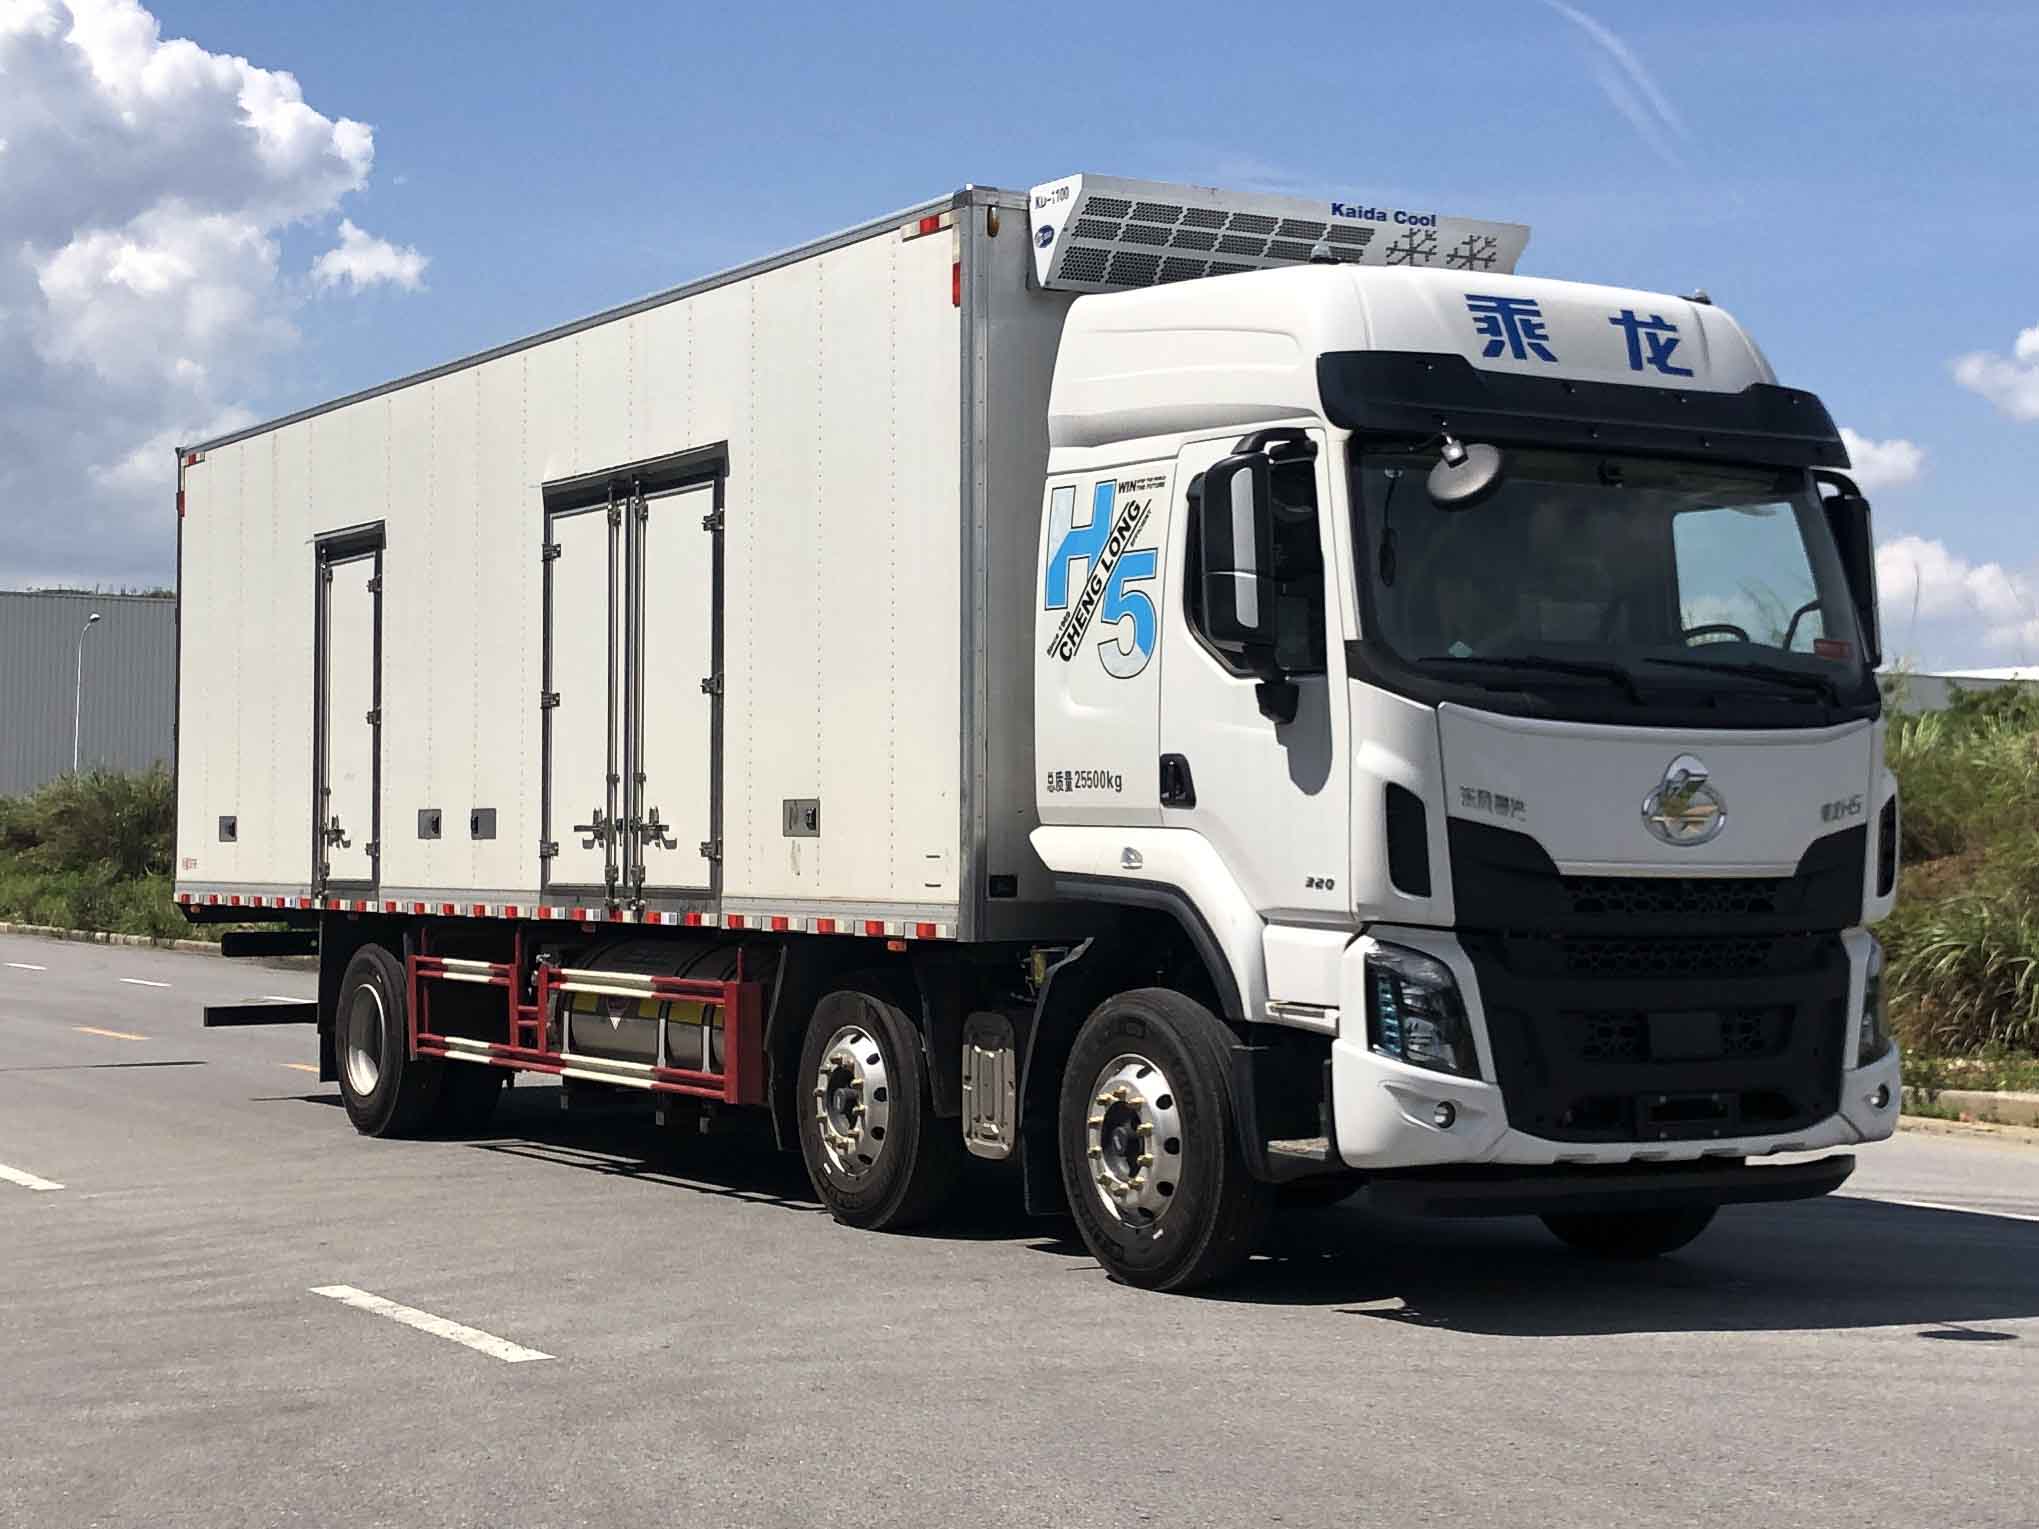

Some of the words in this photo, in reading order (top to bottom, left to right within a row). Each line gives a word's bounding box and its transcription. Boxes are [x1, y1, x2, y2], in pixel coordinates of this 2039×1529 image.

[1331, 202, 1387, 222] Kaida
[1394, 210, 1437, 227] Cool
[1464, 294, 1694, 377] 乘龙
[1118, 479, 1137, 494] WIN
[1059, 573, 1103, 662] CHENG
[1101, 499, 1141, 573] LONG
[1305, 876, 1336, 891] 320
